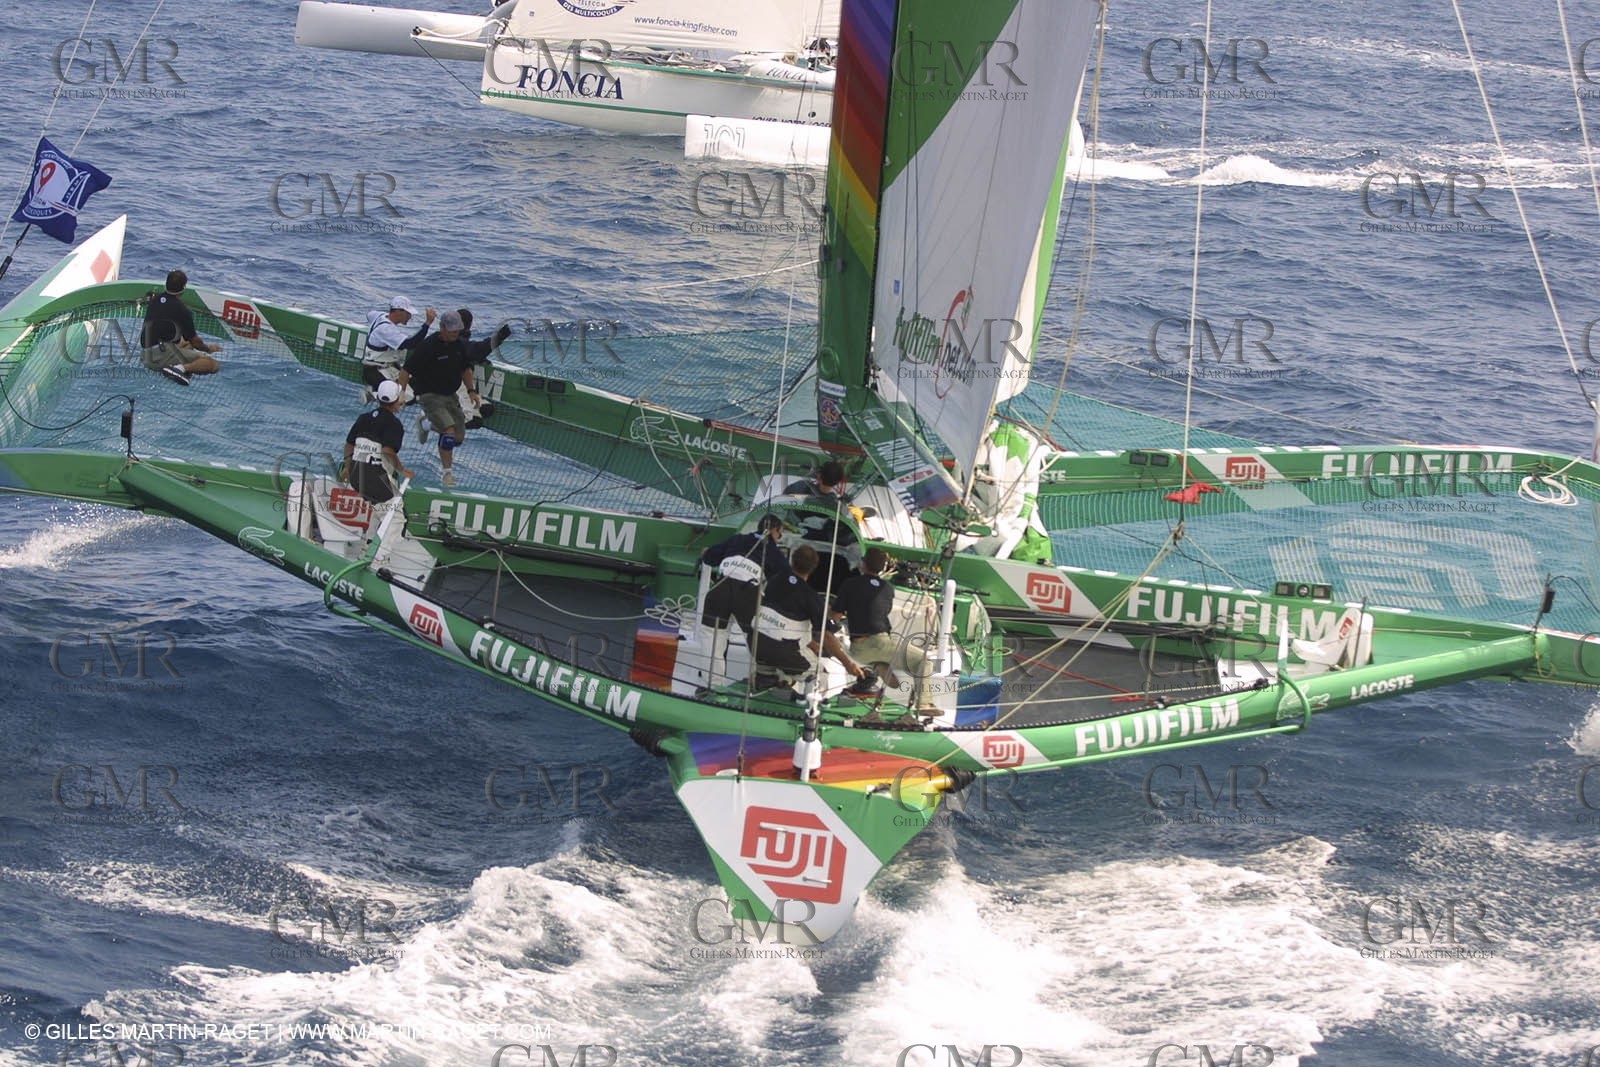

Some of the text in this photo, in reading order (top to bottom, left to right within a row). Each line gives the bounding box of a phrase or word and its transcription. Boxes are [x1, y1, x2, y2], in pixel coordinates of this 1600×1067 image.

[634, 15, 738, 37] www.foncia-kingfisher.com
[517, 64, 624, 100] FONCIA
[684, 432, 748, 461] LACOSTE
[1225, 457, 1266, 483] FUJI
[1322, 454, 1513, 484] FUJIFILM
[428, 499, 637, 554] FUJIFILM
[304, 561, 364, 602] LACOSTE
[1026, 572, 1071, 613] FUJI
[409, 603, 443, 648] FUJI
[469, 629, 642, 722] FUJIFILM
[1351, 674, 1414, 700] LACOSTE
[1075, 698, 1240, 756] FUJIFILM
[983, 735, 1024, 768] FUJI
[741, 805, 847, 904] FUJI
